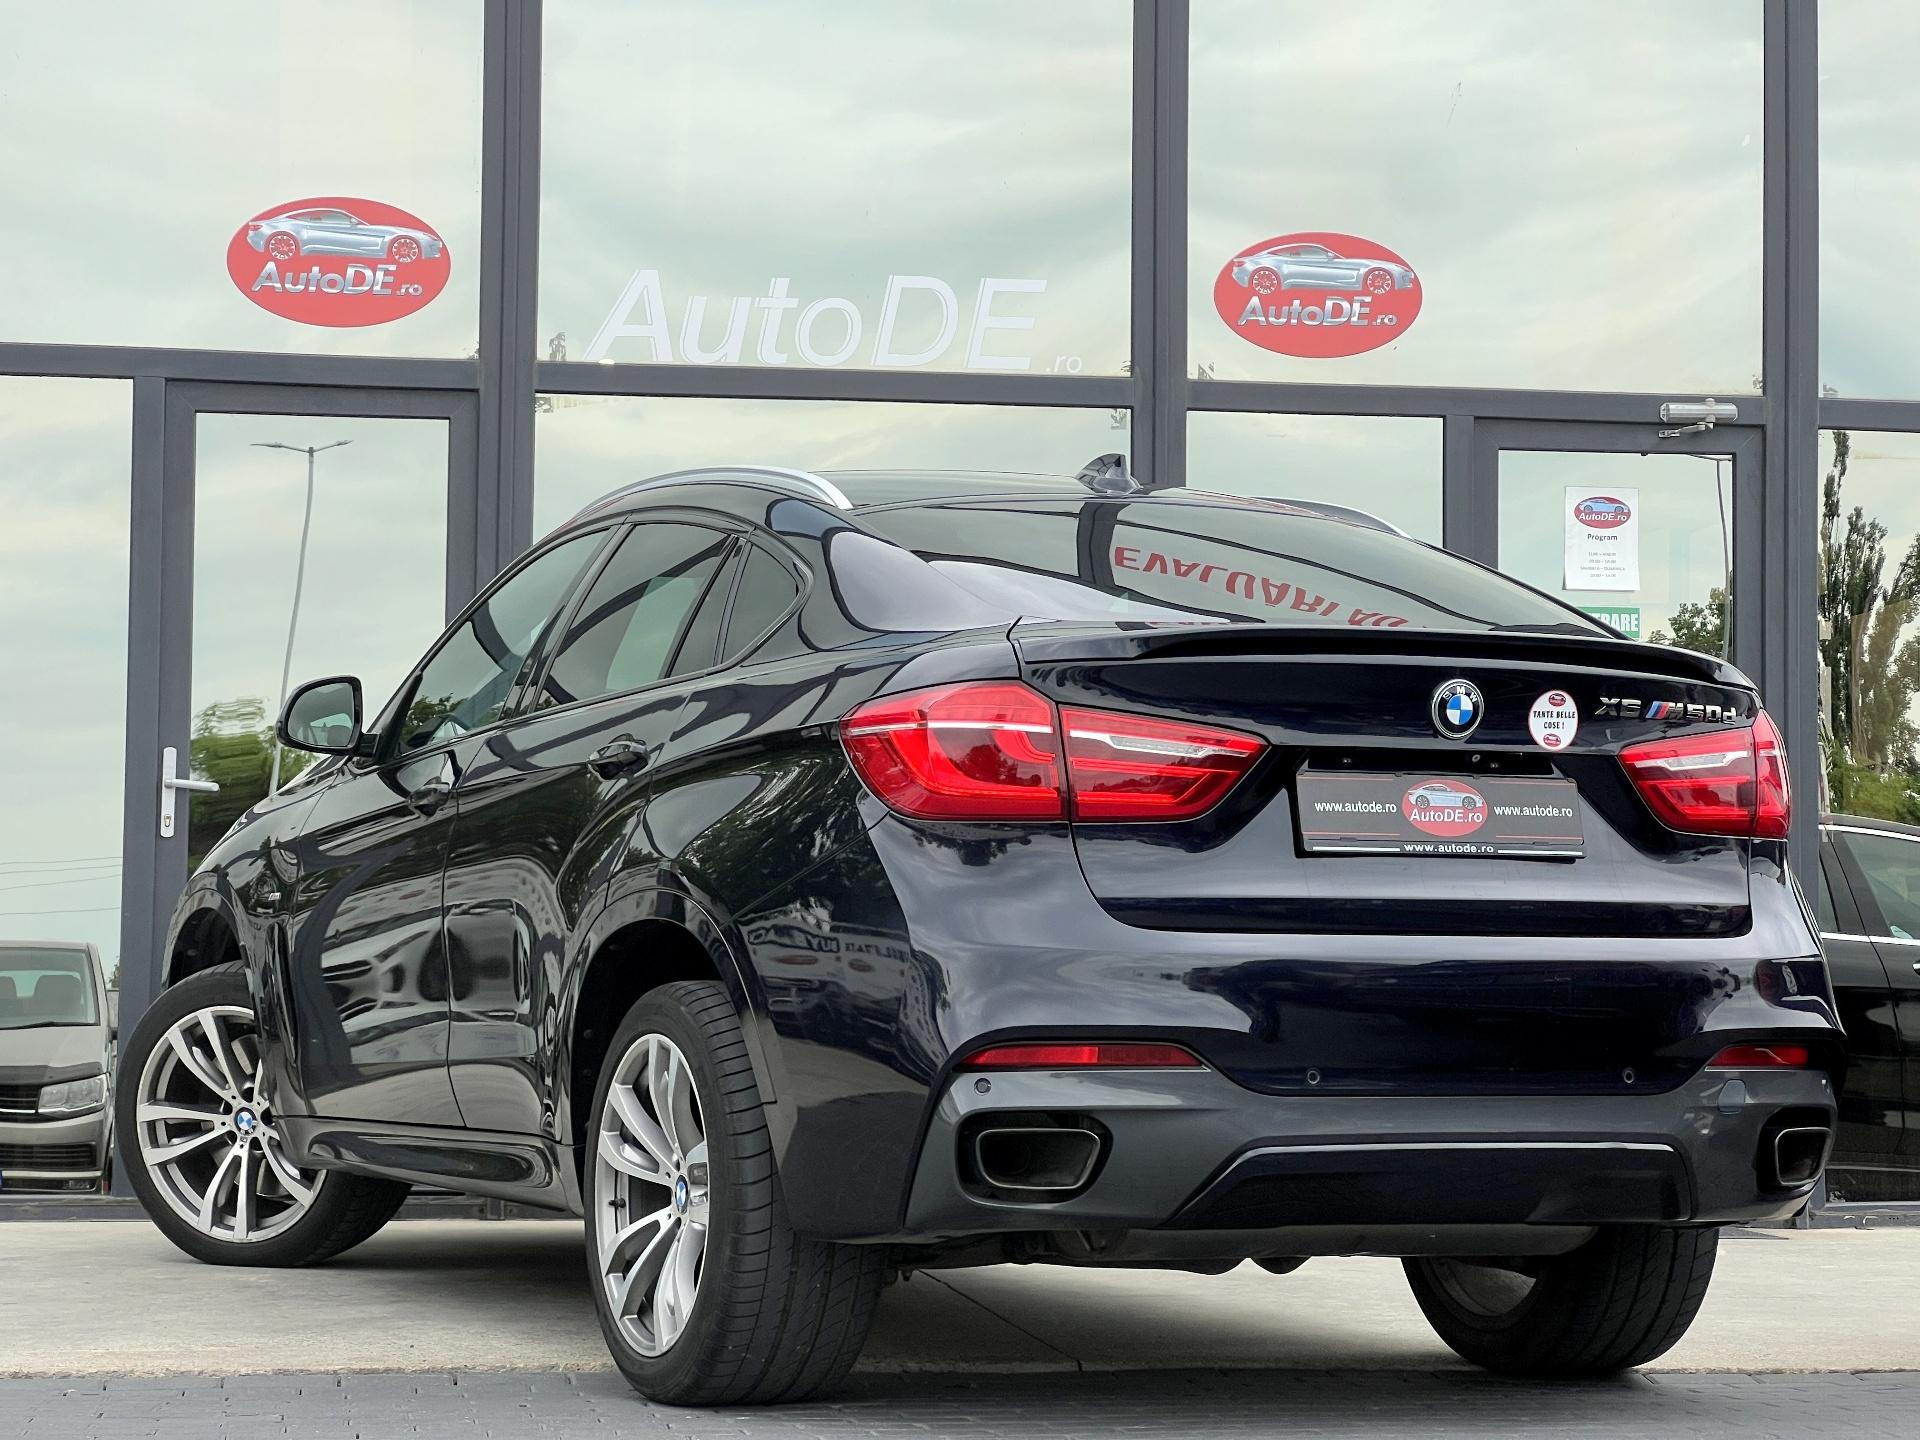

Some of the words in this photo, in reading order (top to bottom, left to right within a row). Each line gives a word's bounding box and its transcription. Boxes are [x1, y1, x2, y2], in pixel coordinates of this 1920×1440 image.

[1587, 533, 1618, 542] Program
[1442, 685, 1478, 703] BMW
[1533, 710, 1554, 719] TANTE
[1556, 710, 1576, 719] BELLE
[1543, 721, 1560, 729] COSE
[1314, 800, 1397, 813] www.autode.ro
[1410, 808, 1483, 823] AutoDE.ro
[1493, 804, 1573, 818] www.autode.ro
[1403, 843, 1494, 854] www.autode.ro
